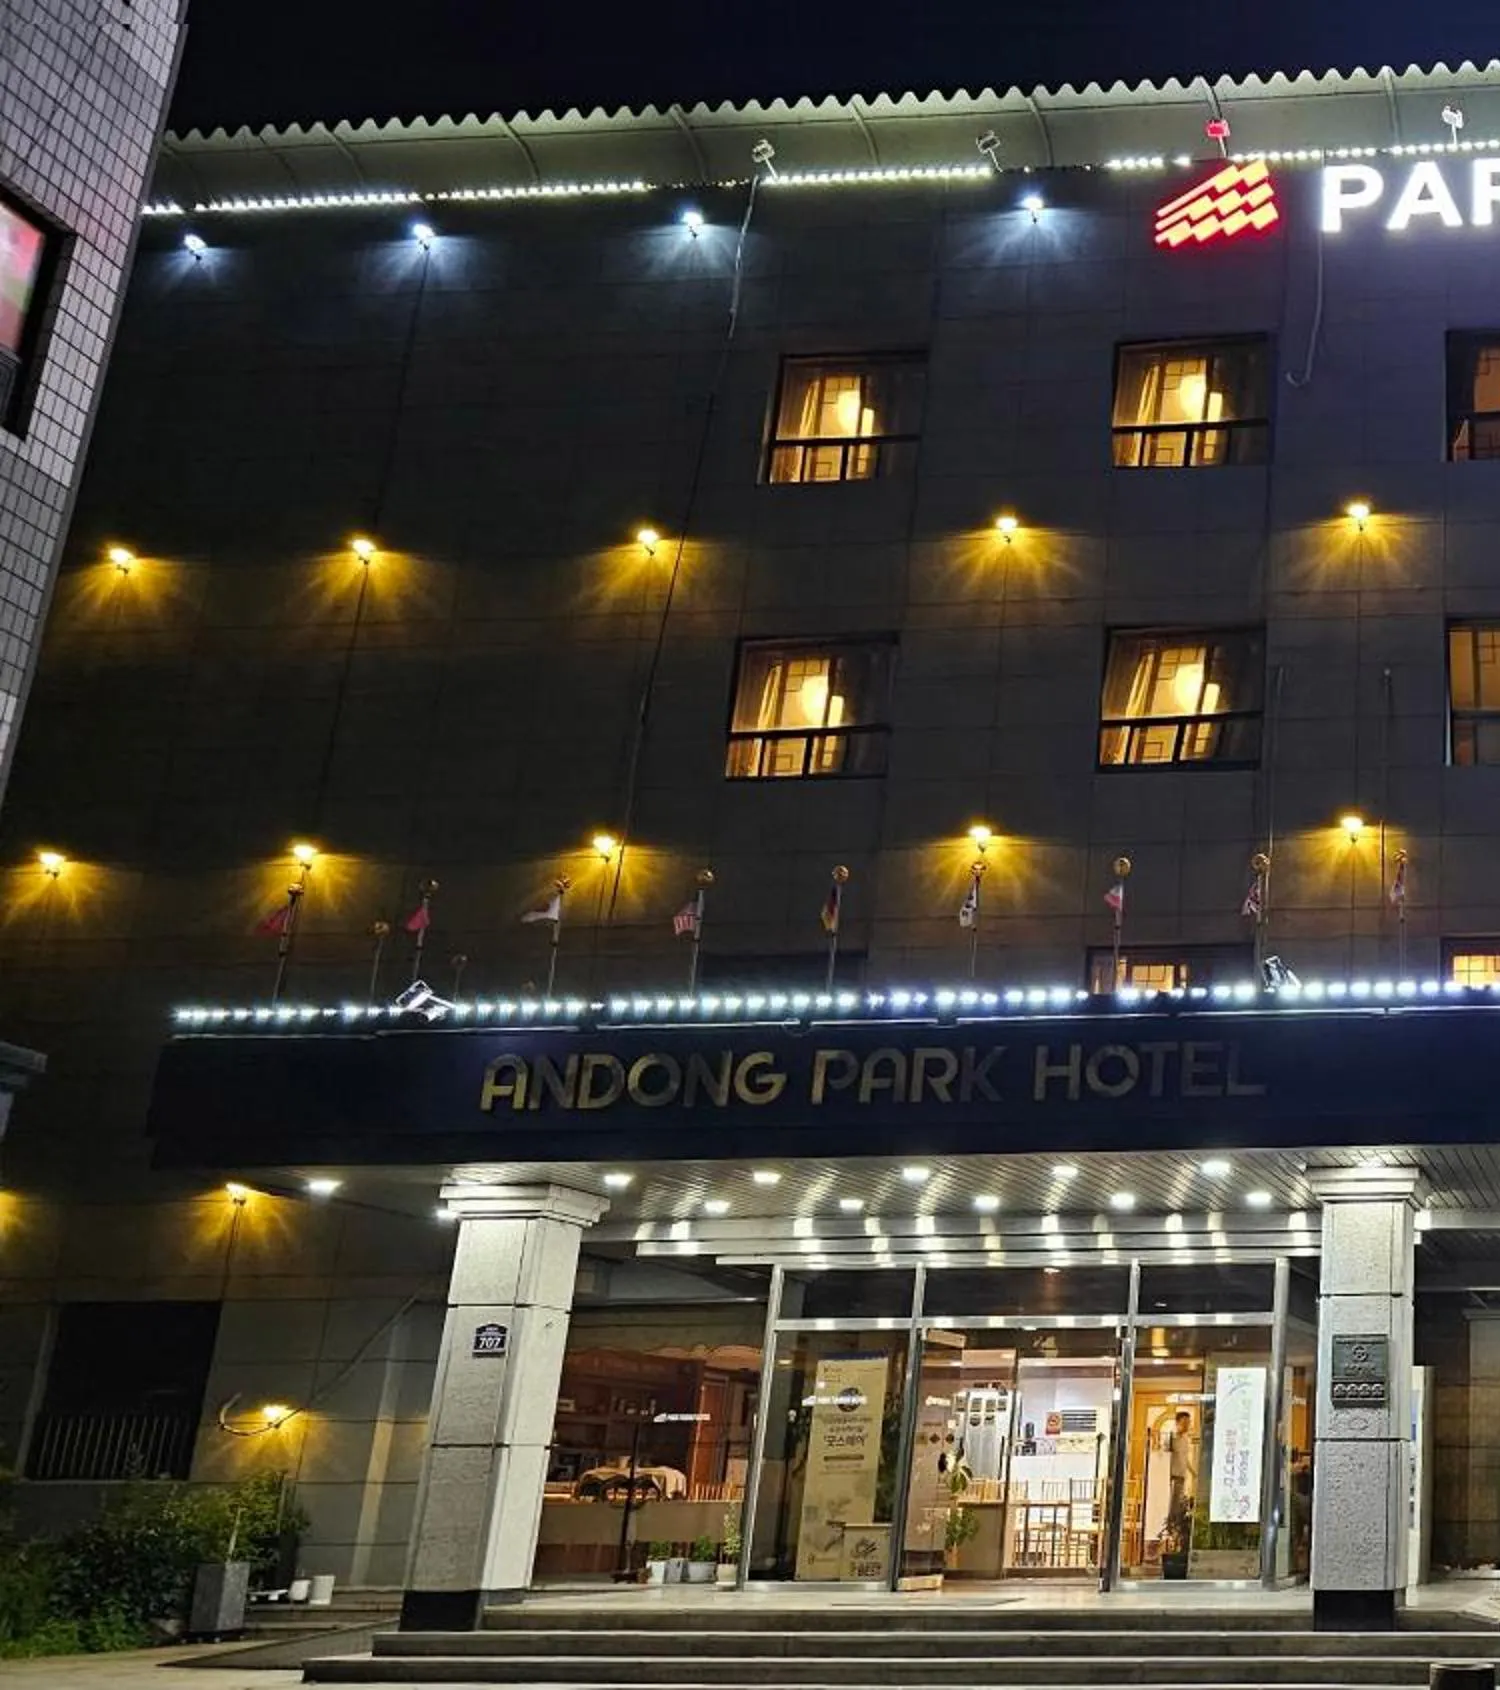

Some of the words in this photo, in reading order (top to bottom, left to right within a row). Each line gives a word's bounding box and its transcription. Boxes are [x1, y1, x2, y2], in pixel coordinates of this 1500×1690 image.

[479, 1051, 787, 1112] ANDONG
[811, 1045, 1005, 1106] PARK
[1034, 1041, 1268, 1103] HOTEL
[479, 1337, 501, 1350] 707
